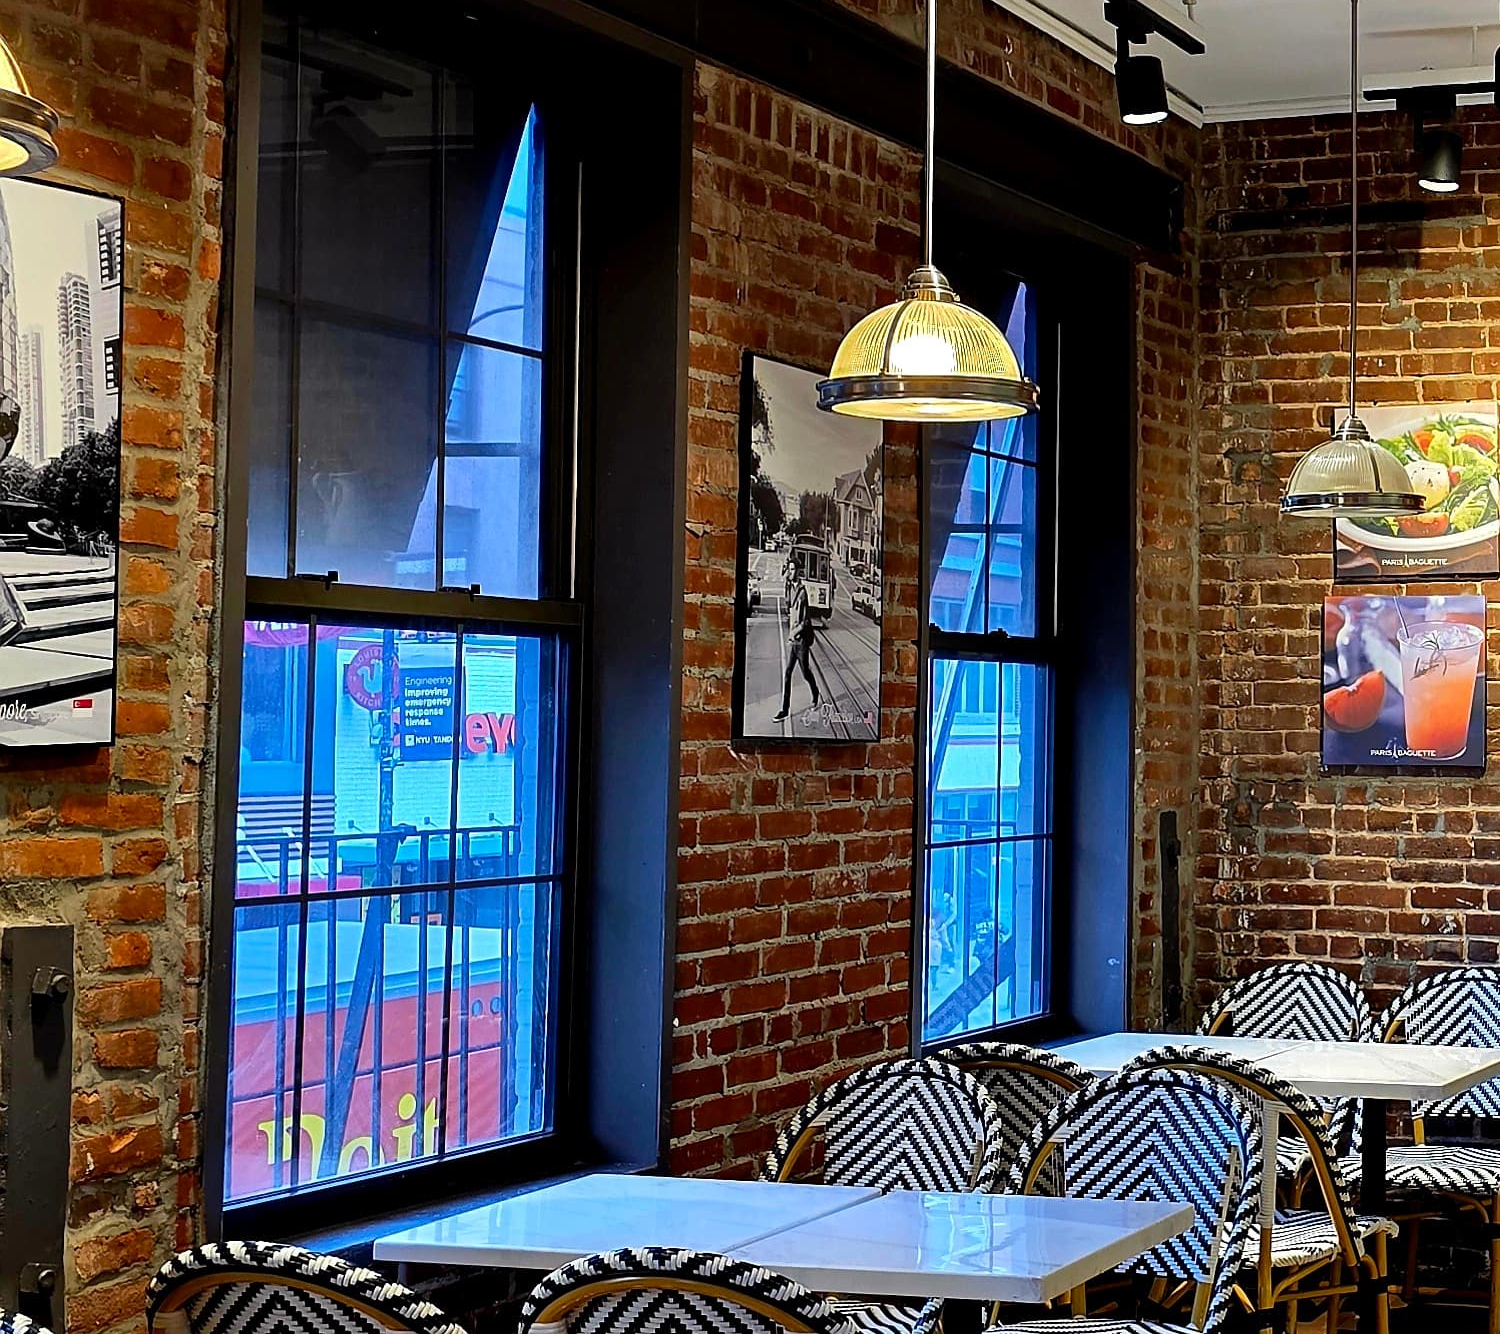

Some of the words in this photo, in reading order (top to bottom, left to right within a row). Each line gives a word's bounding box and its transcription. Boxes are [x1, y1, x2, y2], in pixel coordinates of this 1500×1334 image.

[1409, 558, 1448, 566] BAGUETTE
[404, 676, 453, 686] Engineering
[404, 697, 452, 707] emergency
[404, 708, 444, 718] response
[415, 735, 431, 745] NYU
